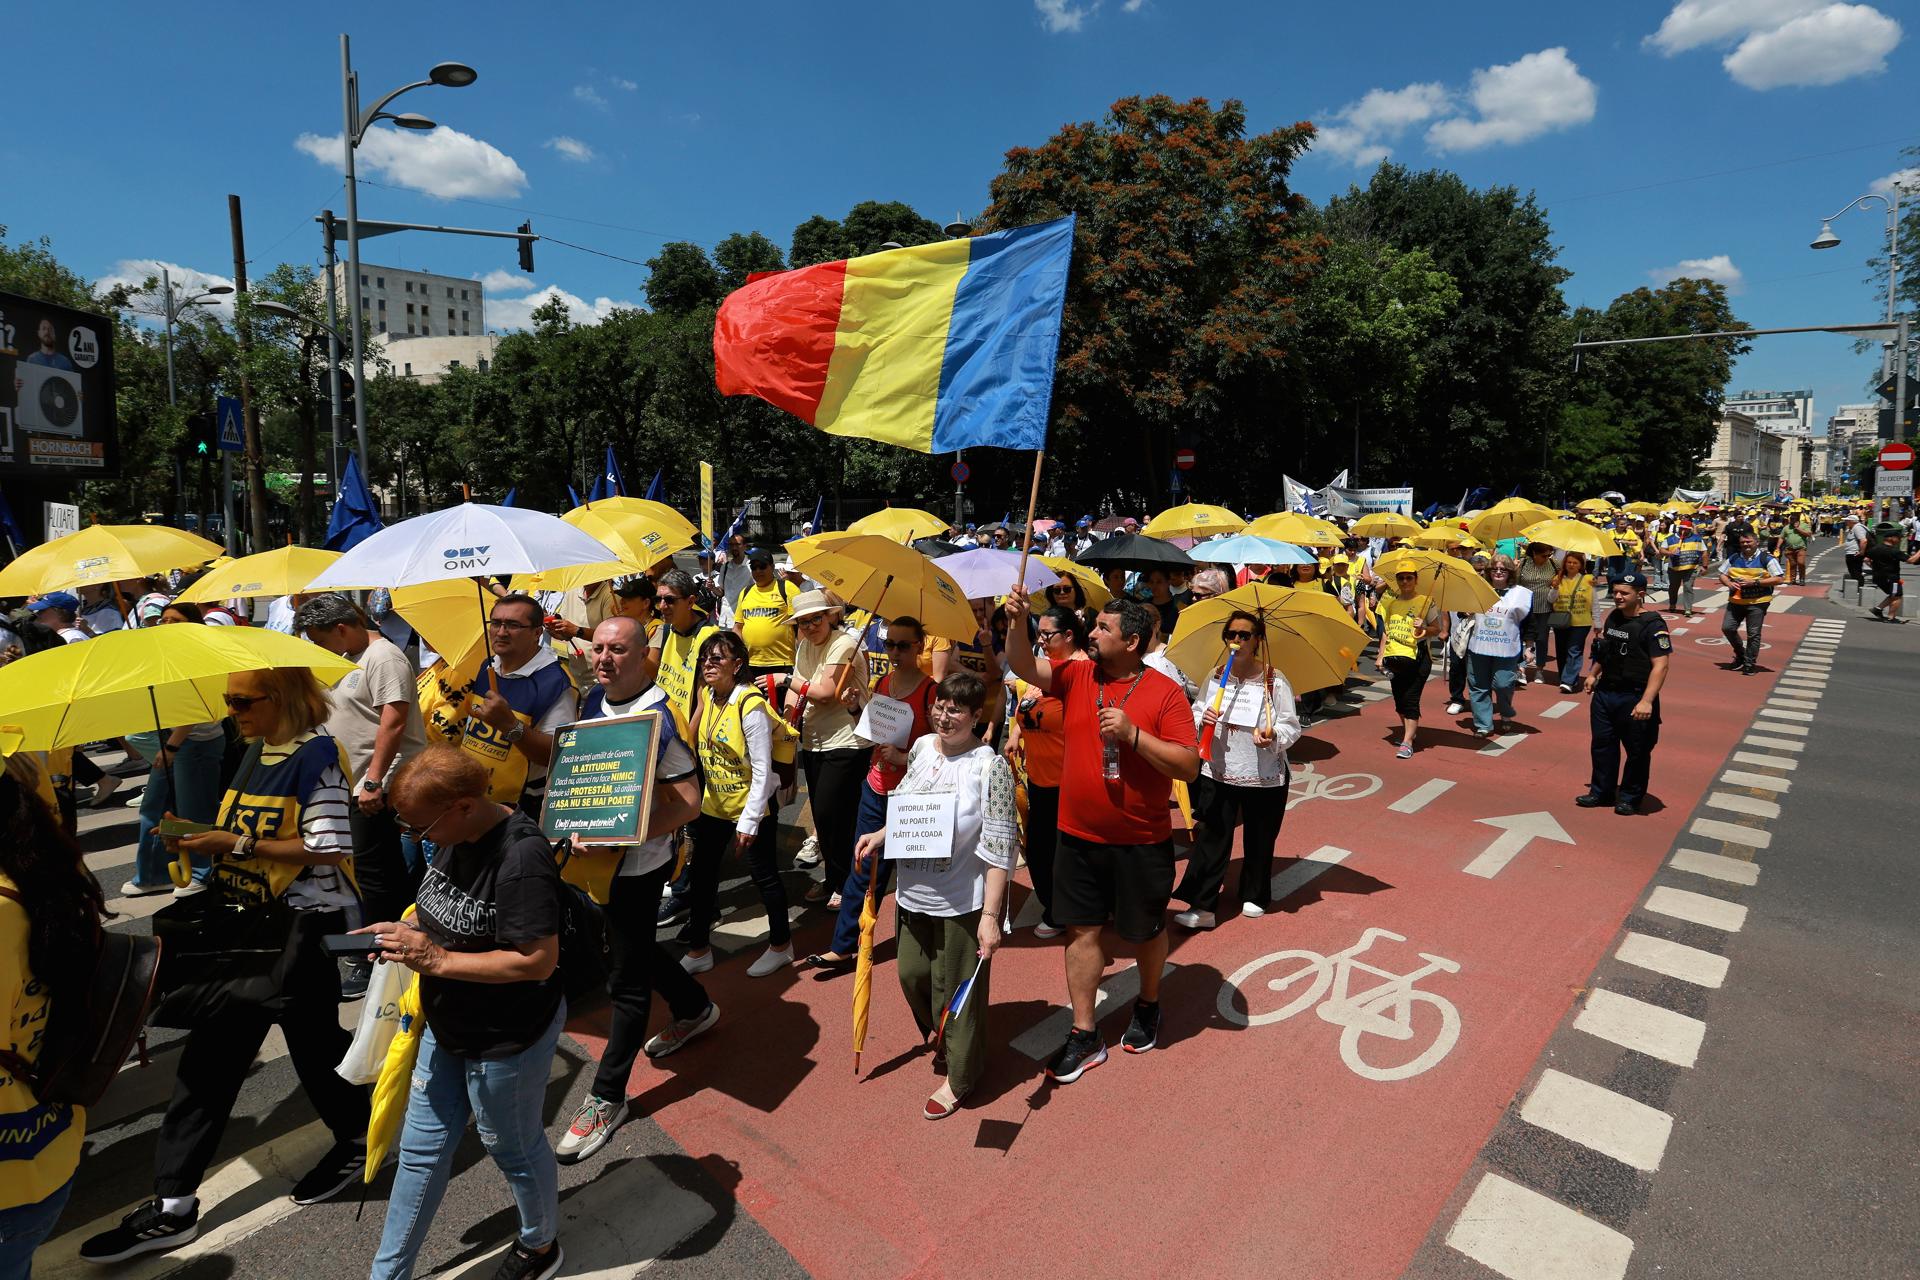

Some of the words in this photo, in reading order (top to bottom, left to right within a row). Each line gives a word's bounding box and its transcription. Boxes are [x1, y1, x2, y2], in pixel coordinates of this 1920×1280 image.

[73, 330, 82, 352] 2
[83, 342, 95, 353] ANI
[32, 439, 92, 455] HORNBACH
[444, 557, 490, 570] OMV
[607, 750, 614, 758] de
[571, 765, 579, 773] IA
[580, 761, 621, 773] ATITUDINE!
[611, 771, 636, 781] NIMIC!
[555, 799, 569, 810] AȘA
[570, 798, 581, 807] NU
[582, 798, 592, 806] SE
[592, 797, 606, 806] MAI
[607, 795, 635, 805] POATE!
[898, 804, 924, 812] VIITORUL
[231, 809, 280, 839] SE
[909, 817, 928, 825] POATE
[921, 830, 943, 838] COADA
[906, 844, 927, 852] GRILEI.
